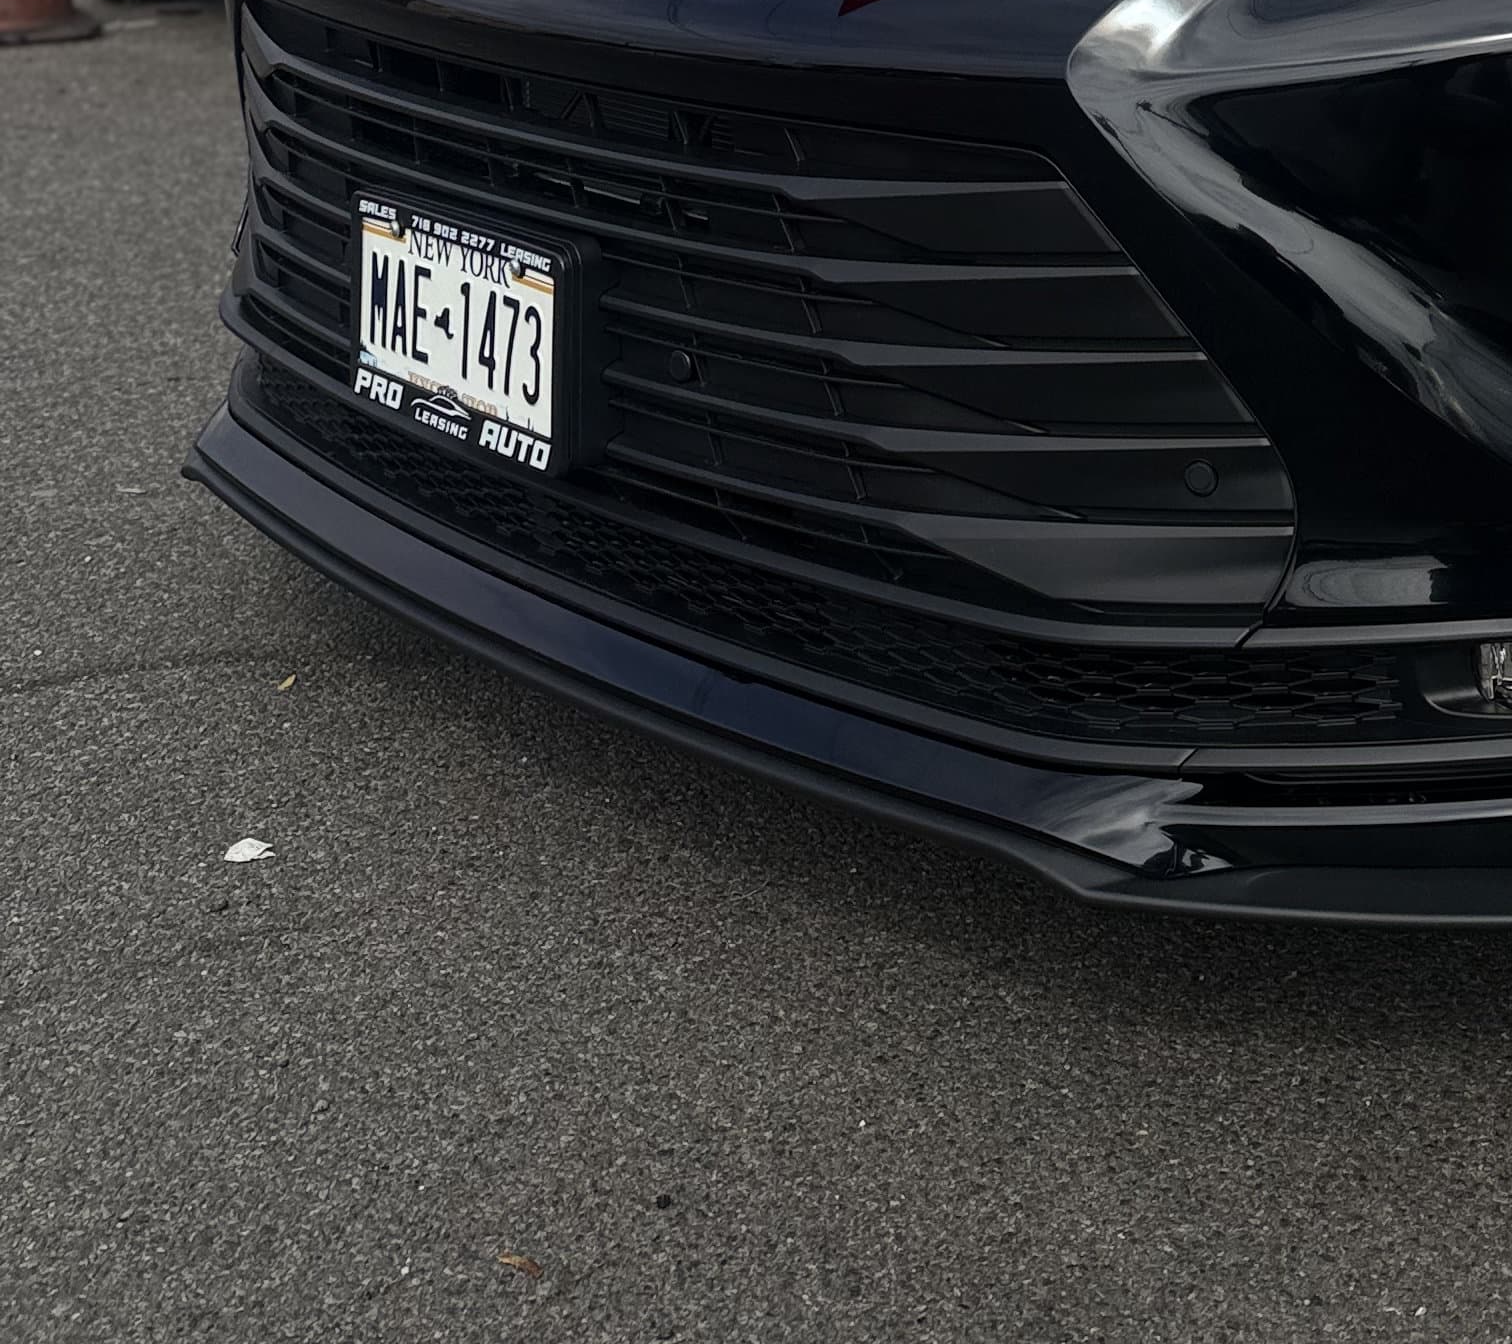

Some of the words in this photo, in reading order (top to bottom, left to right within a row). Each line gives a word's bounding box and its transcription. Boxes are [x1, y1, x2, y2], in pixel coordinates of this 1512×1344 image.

[359, 200, 396, 220] SALES
[411, 215, 431, 232] 718
[433, 222, 458, 241] 902
[461, 231, 495, 252] 2277
[500, 243, 551, 272] LEASING
[408, 229, 451, 267] NEW
[460, 245, 510, 289] YORK
[370, 251, 432, 365] MAE
[460, 281, 542, 406] 1473
[354, 367, 404, 410] PRO
[415, 407, 468, 441] LEASING
[478, 419, 552, 471] AUTO
